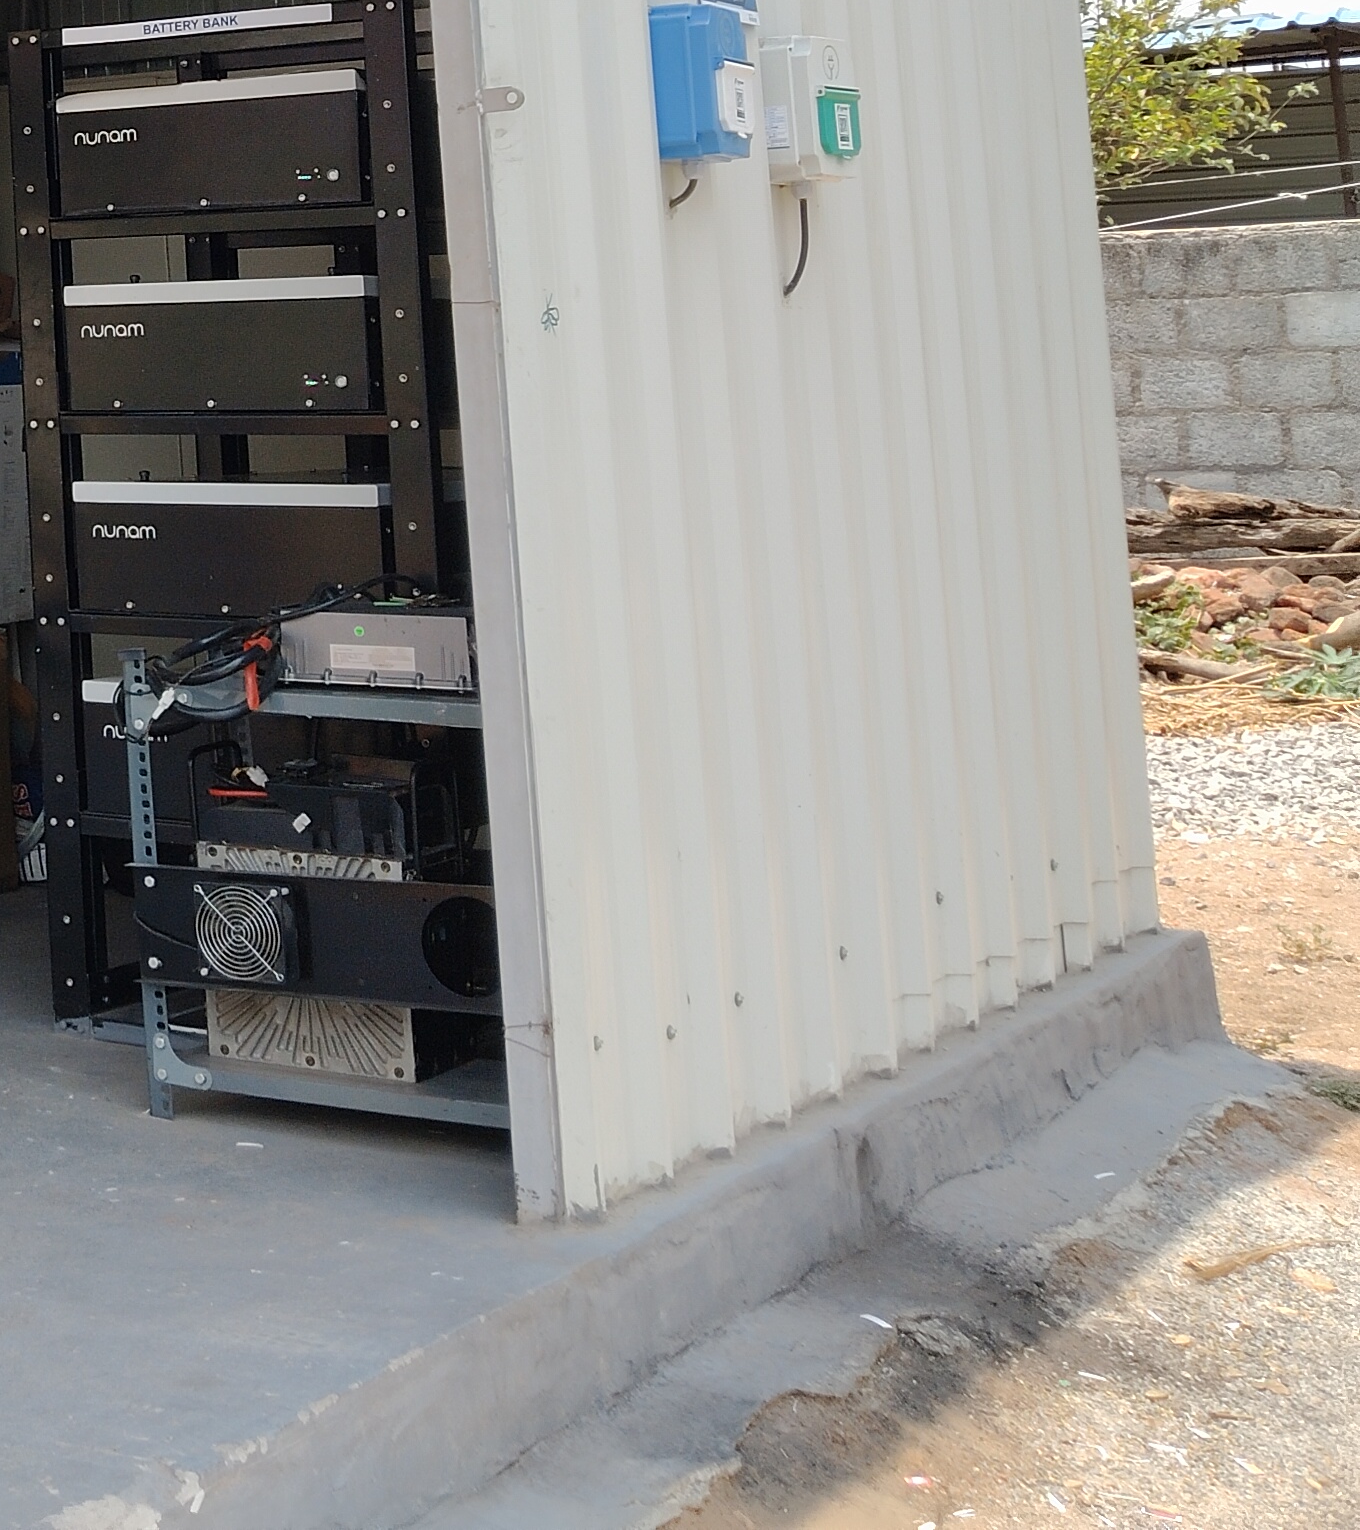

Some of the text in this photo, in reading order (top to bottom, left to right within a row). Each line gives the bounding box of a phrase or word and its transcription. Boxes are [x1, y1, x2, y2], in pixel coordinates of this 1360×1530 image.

[143, 15, 238, 35] BATTERY BANK
[73, 127, 137, 146] nunam
[80, 321, 145, 339] nunam
[91, 523, 157, 541] nunam
